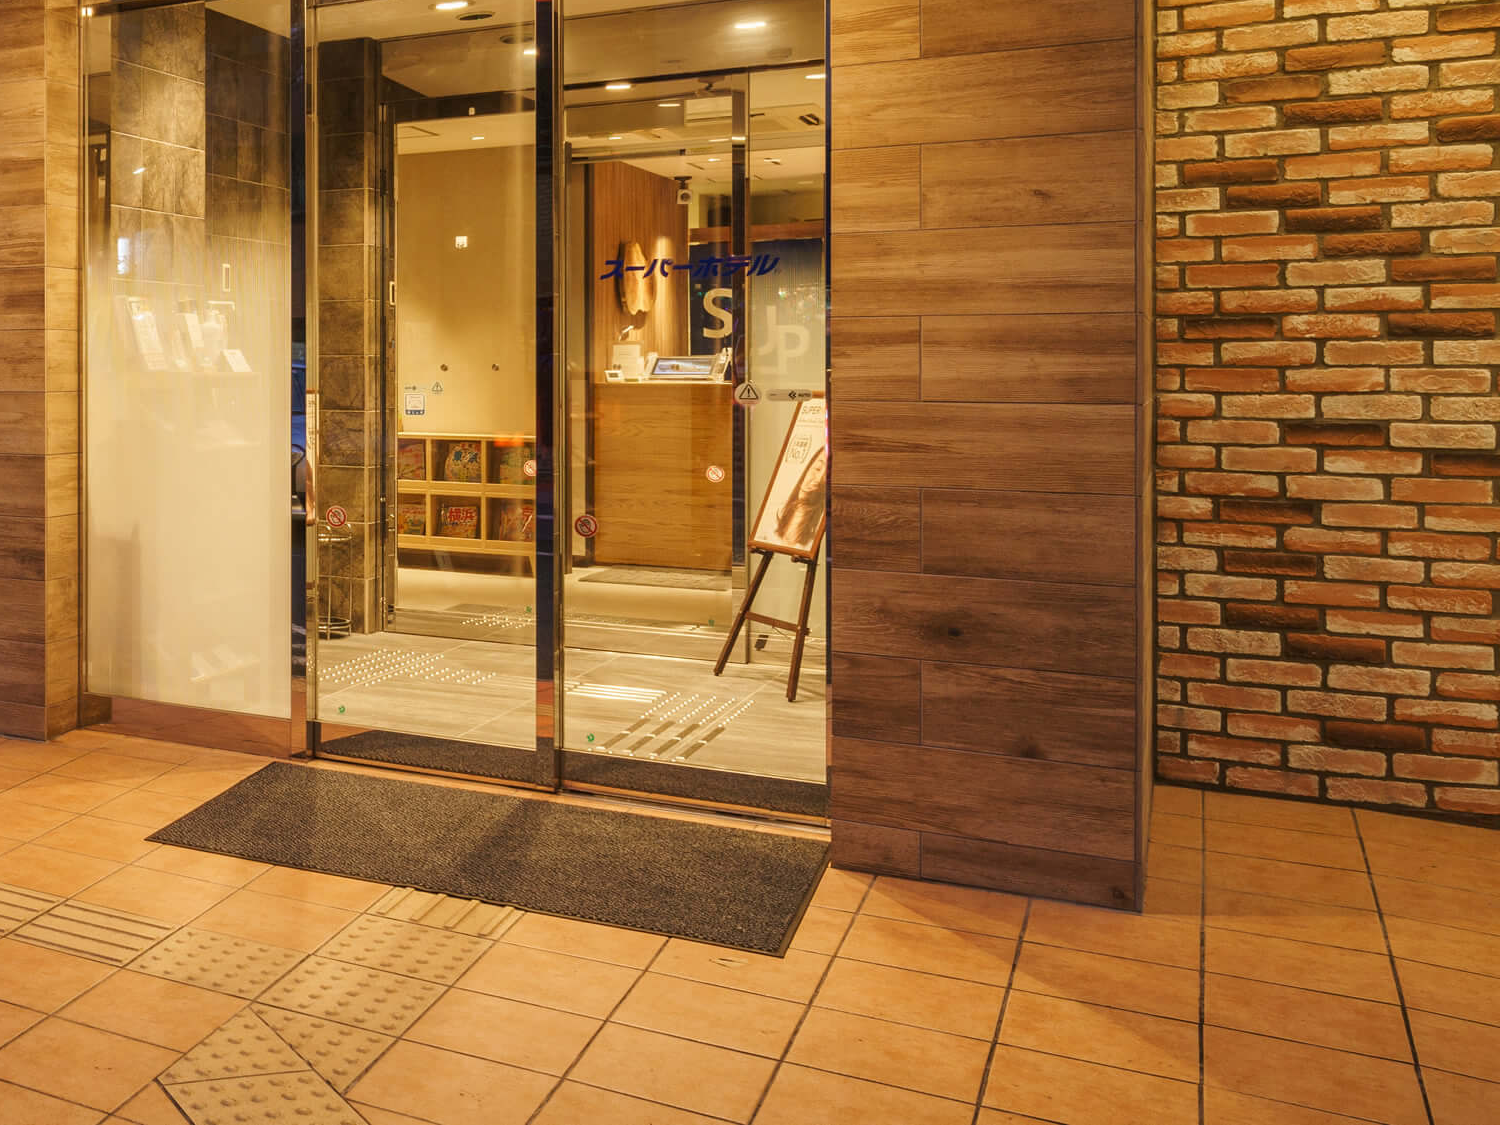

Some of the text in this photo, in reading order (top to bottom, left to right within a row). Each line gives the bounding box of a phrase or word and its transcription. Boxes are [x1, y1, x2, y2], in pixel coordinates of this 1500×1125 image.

[600, 254, 781, 280] スーパーホテル
